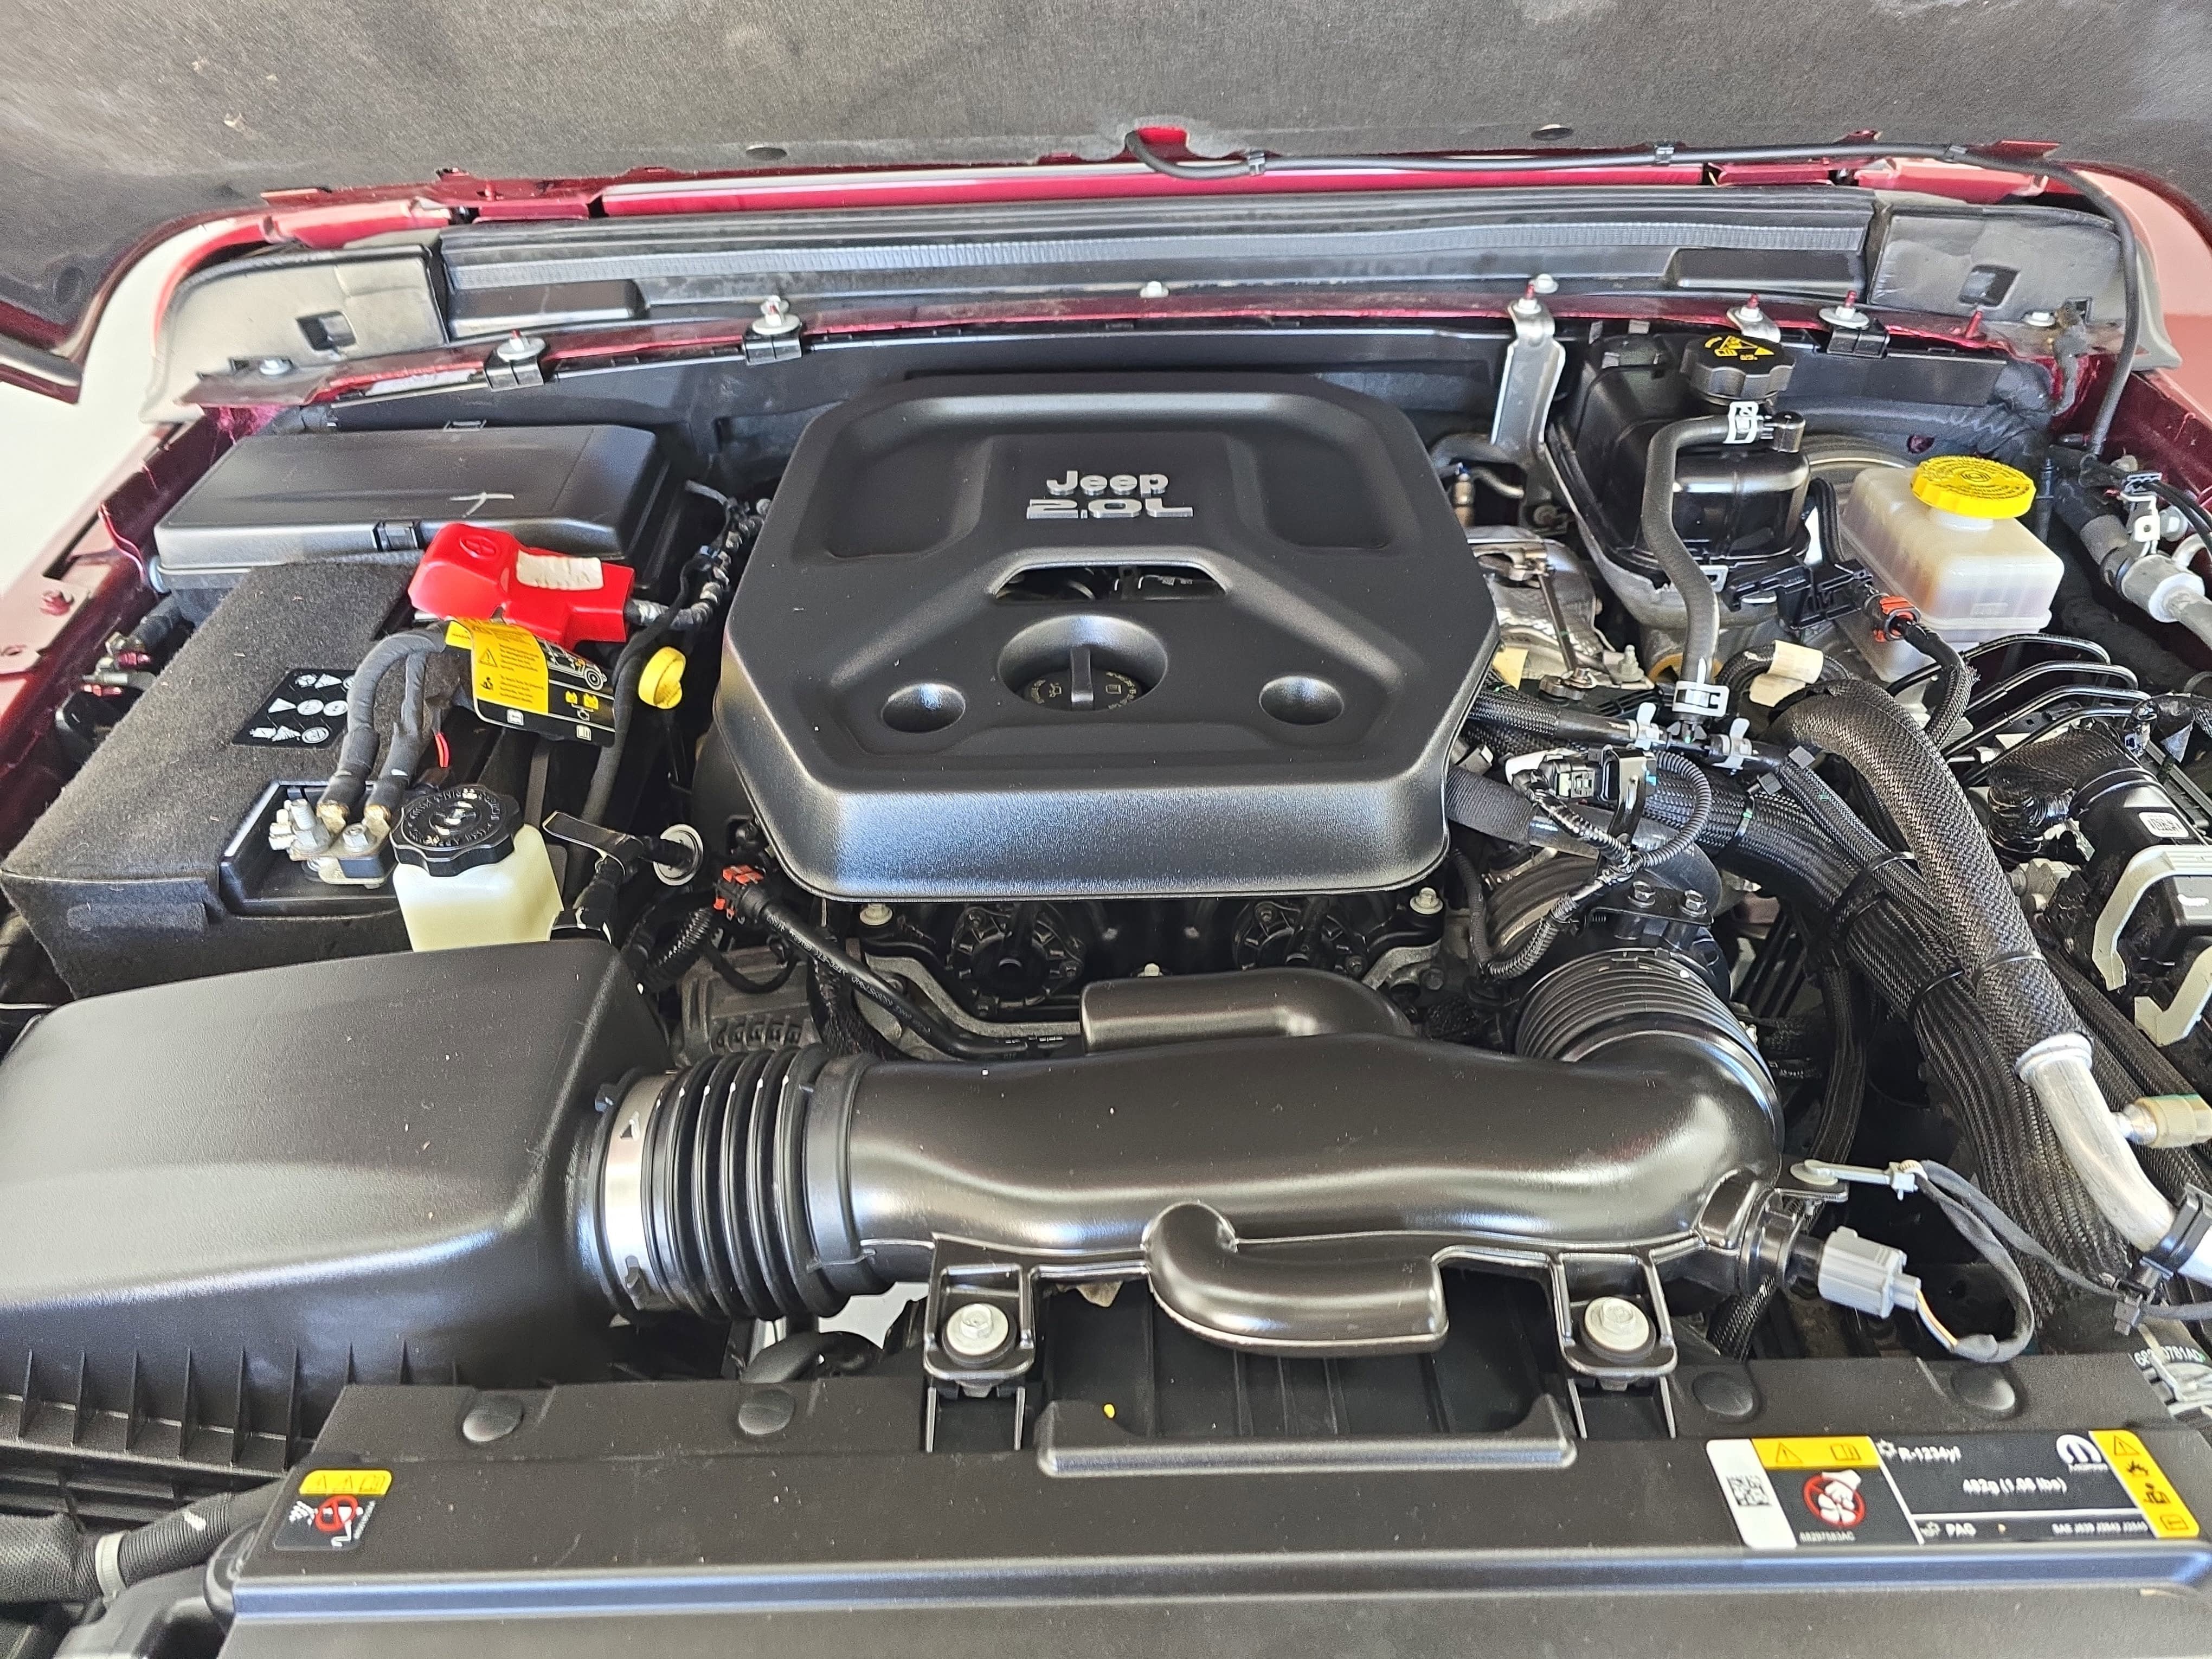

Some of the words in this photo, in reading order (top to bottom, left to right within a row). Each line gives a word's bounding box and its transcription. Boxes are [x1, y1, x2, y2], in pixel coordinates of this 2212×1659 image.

[1046, 470, 1168, 498] Jeep
[1026, 497, 1193, 519] 2.0L
[1898, 1445, 1962, 1463] R-1234yf
[1945, 1522, 1976, 1534] PAG
[2052, 1522, 2073, 1534] SAE
